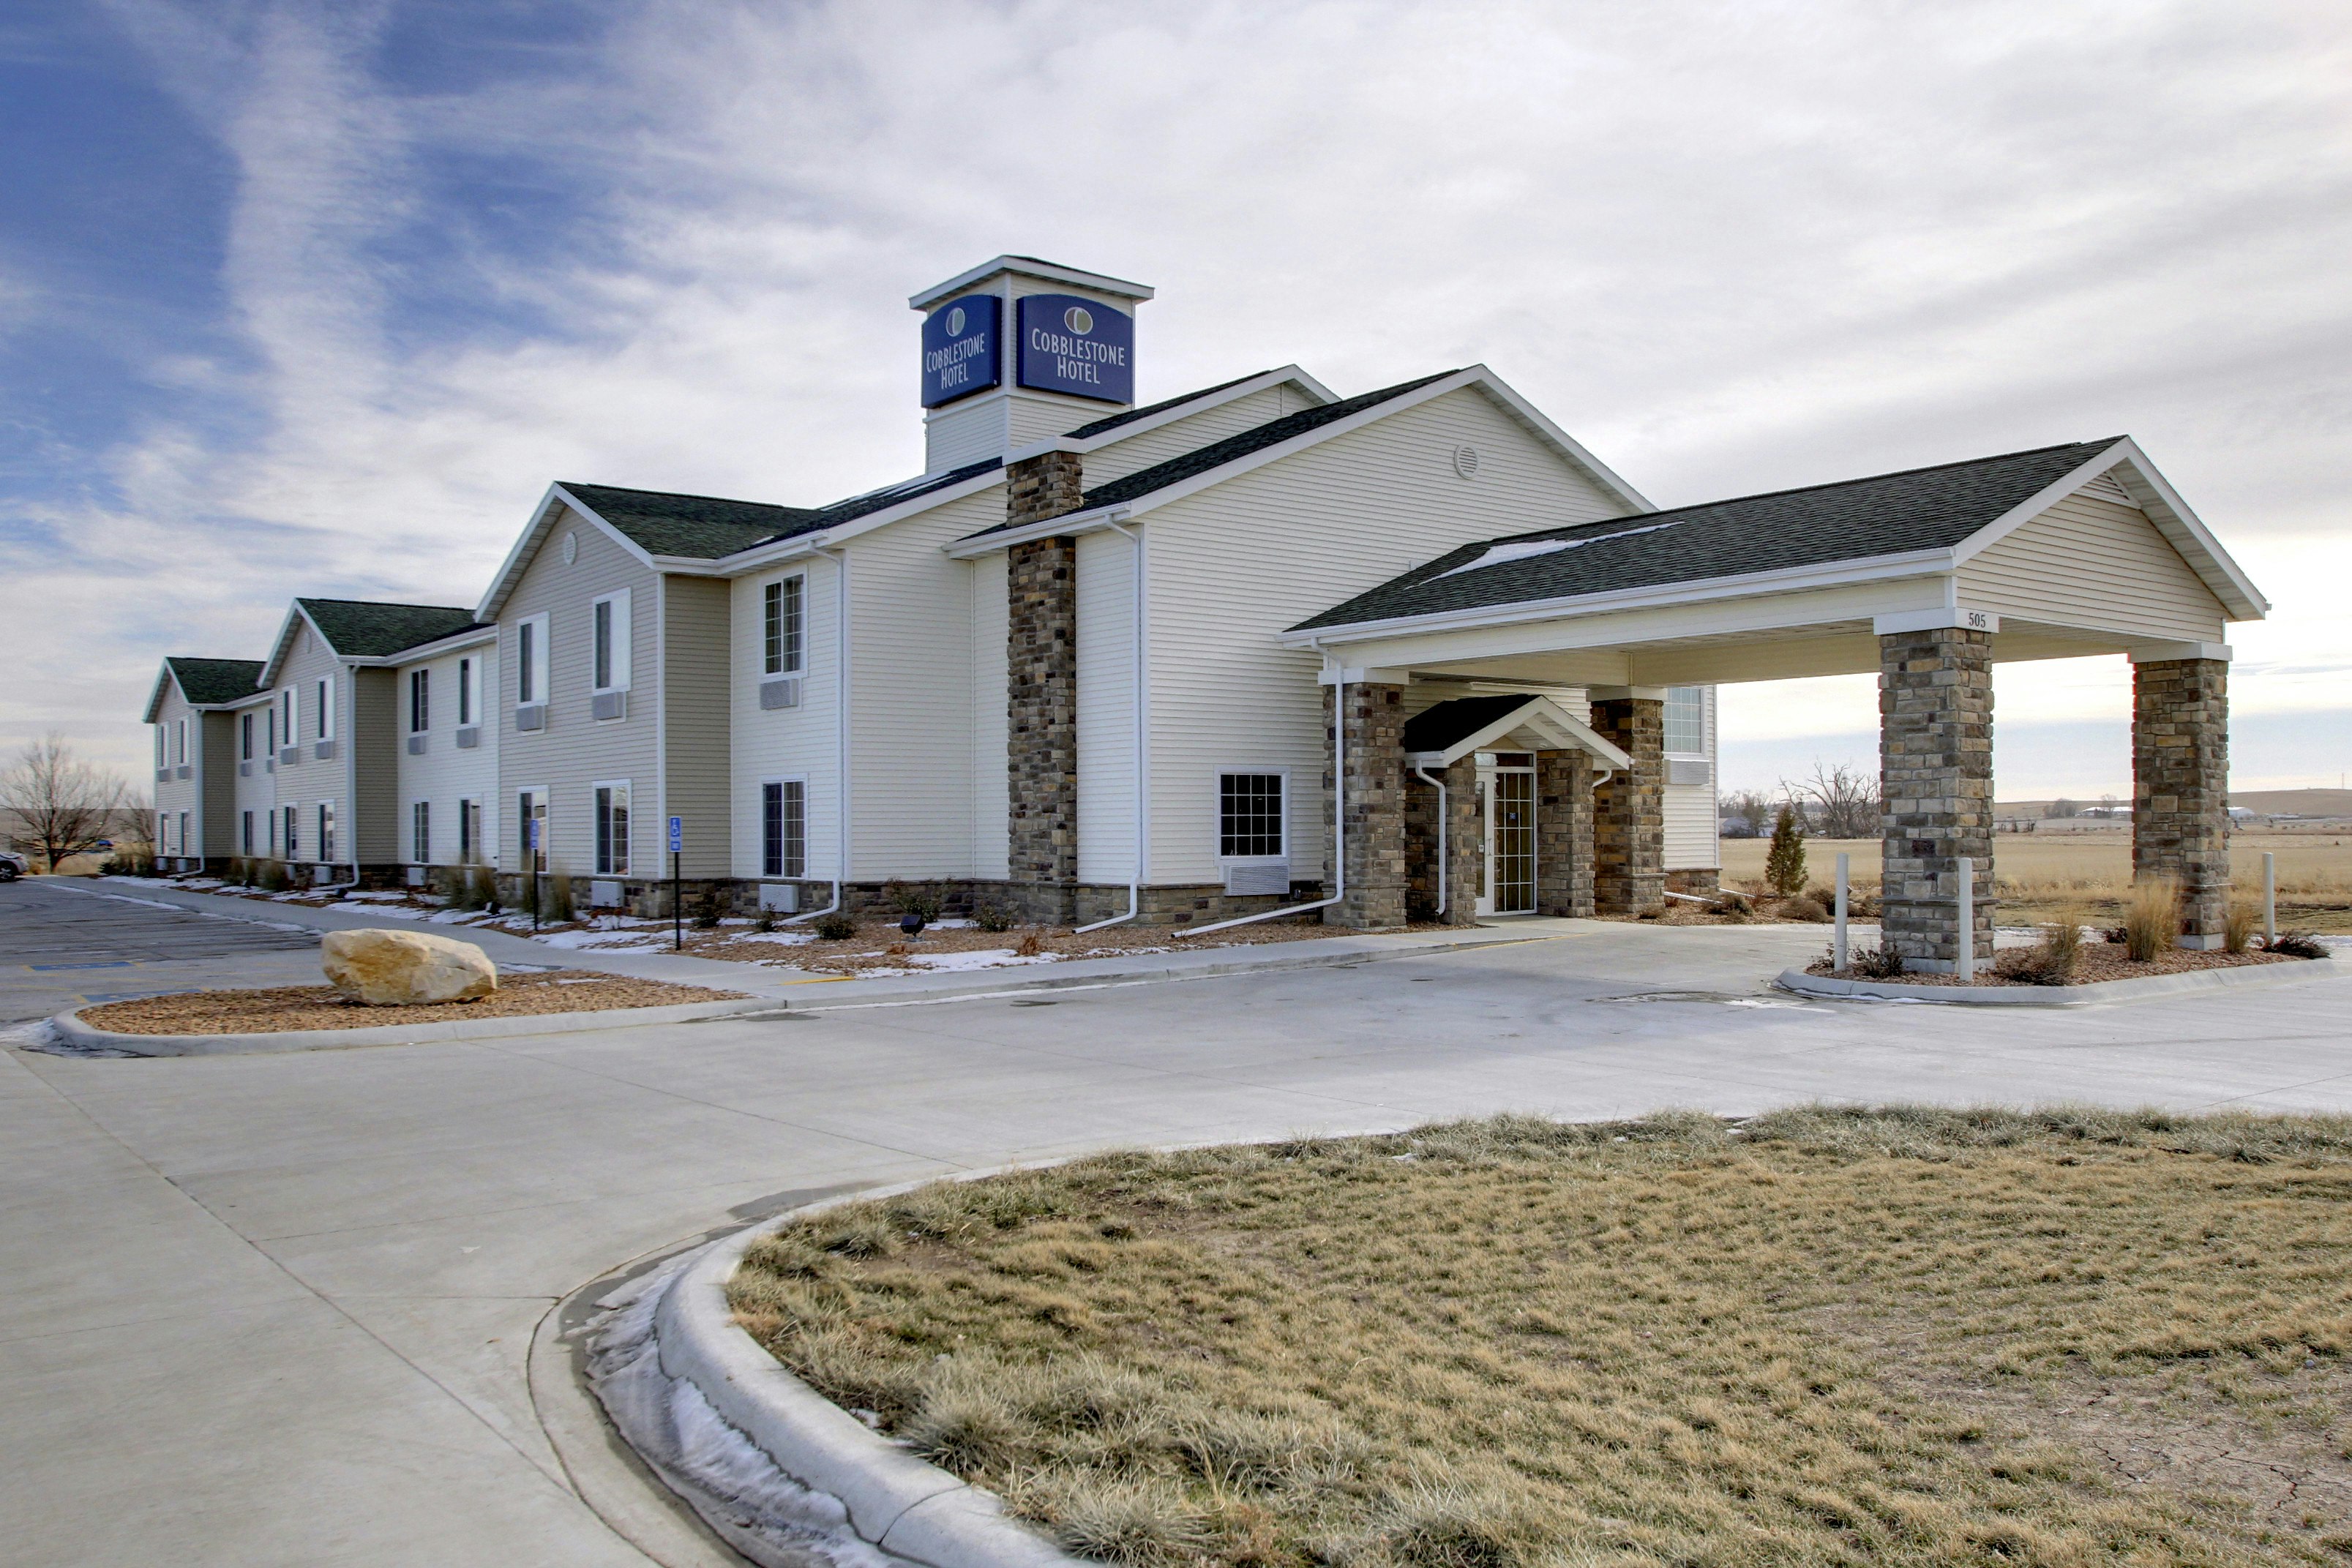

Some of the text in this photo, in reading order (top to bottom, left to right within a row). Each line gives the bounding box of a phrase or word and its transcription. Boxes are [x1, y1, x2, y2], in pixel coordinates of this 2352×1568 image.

[926, 333, 984, 372] COBBLESTONE
[1032, 328, 1125, 366] COBBLESTONE
[941, 362, 968, 390] HOTEL
[1057, 356, 1100, 384] HOTEL
[1969, 612, 1985, 628] 505
